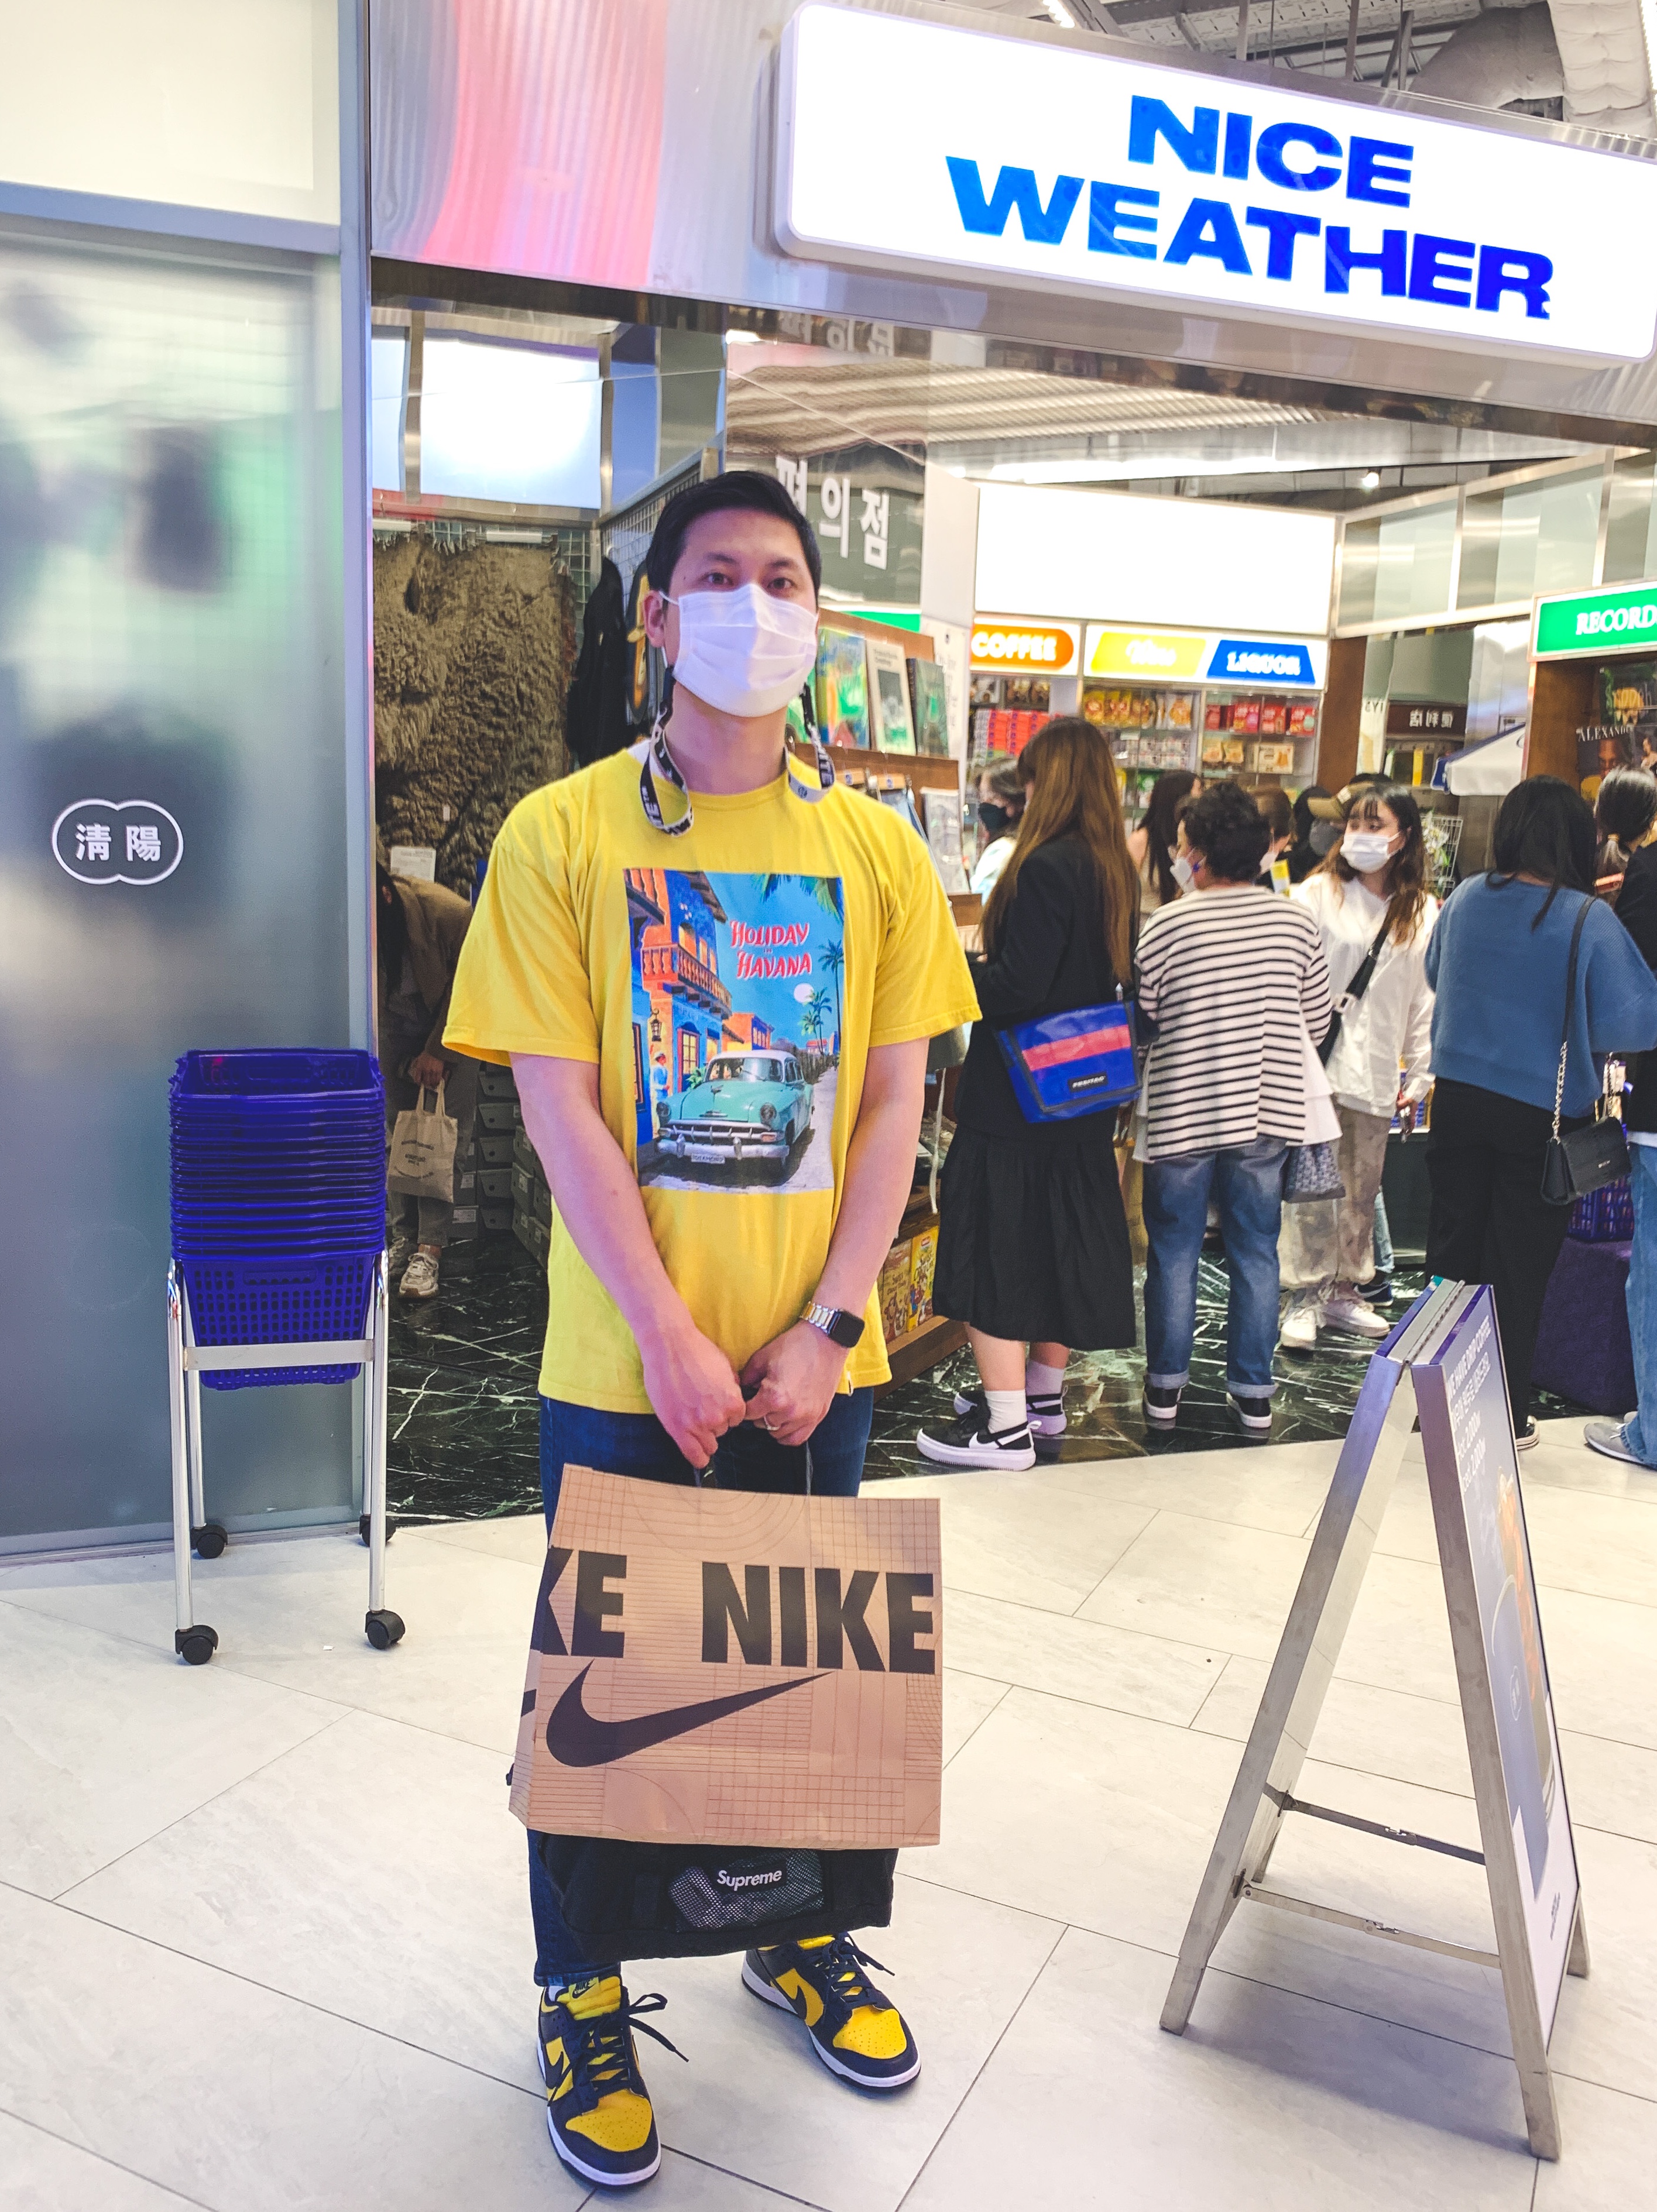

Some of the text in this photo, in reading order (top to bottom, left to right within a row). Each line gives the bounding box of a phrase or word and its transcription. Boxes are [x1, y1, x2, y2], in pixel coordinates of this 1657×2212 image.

[1127, 95, 1414, 208] NICE
[945, 156, 1553, 321] WEATHER
[970, 631, 1058, 661] COFFEE
[1226, 651, 1301, 676] LIQUOR
[1577, 723, 1632, 742] ALEXAND
[730, 919, 810, 950] HOLIDAY
[736, 950, 812, 981] HAVANA
[702, 1561, 935, 1675] NIKE
[716, 1870, 782, 1891] Supreme
